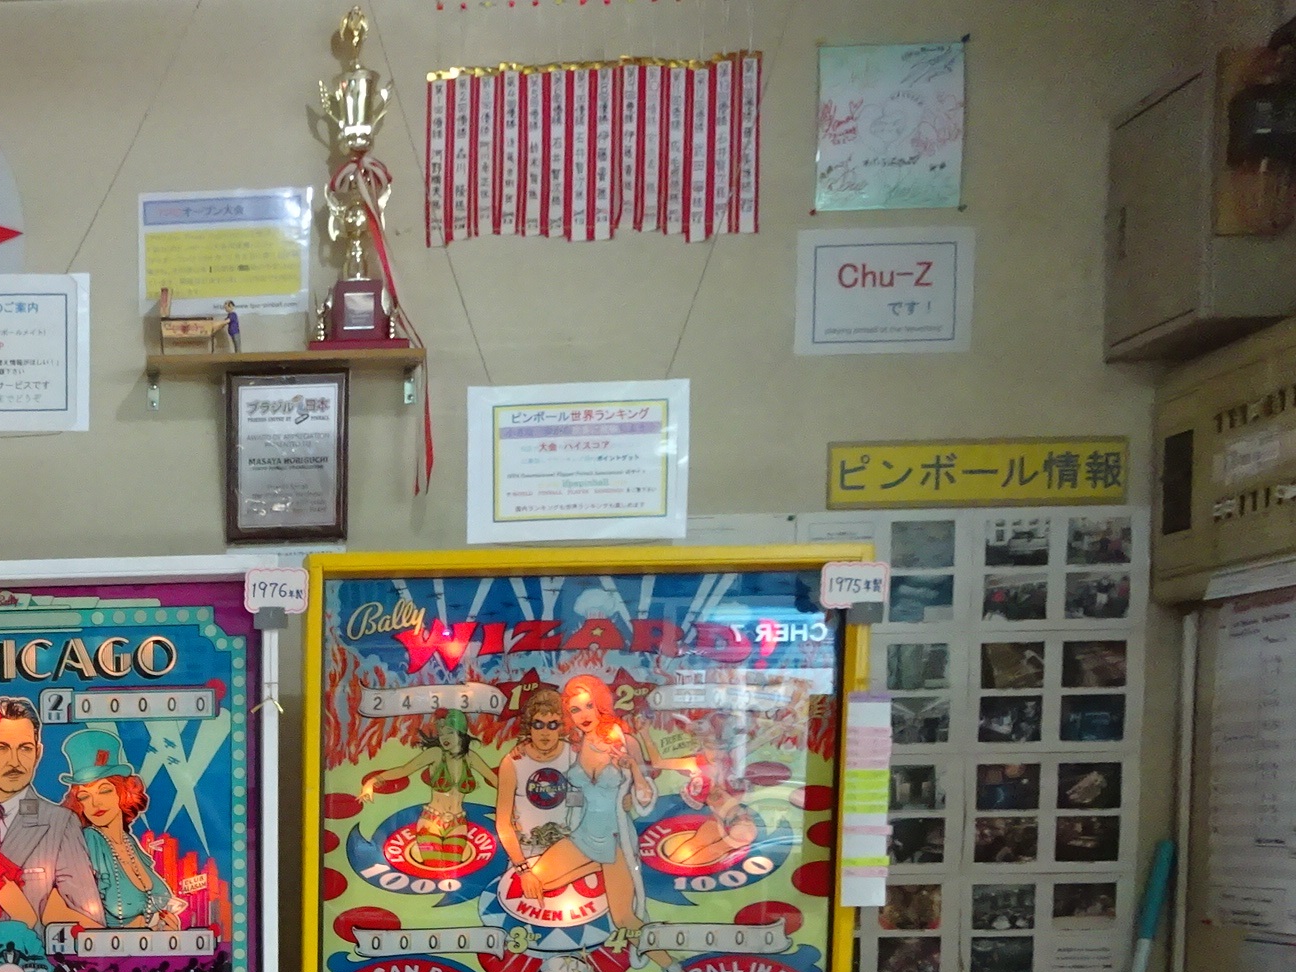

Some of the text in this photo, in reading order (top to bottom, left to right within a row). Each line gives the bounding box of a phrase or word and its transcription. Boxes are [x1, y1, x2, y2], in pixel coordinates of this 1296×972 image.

[511, 407, 651, 425] ピンボール世界ランキング
[564, 440, 611, 451] ハイスコア
[838, 450, 1125, 491] ピンボール情報
[346, 598, 426, 641] Bally
[388, 826, 493, 863] LOVE LOVE
[639, 824, 672, 858] EVIL
[360, 863, 462, 892] 1000
[673, 855, 775, 891] 1000
[515, 900, 597, 922] WHEN LIT
